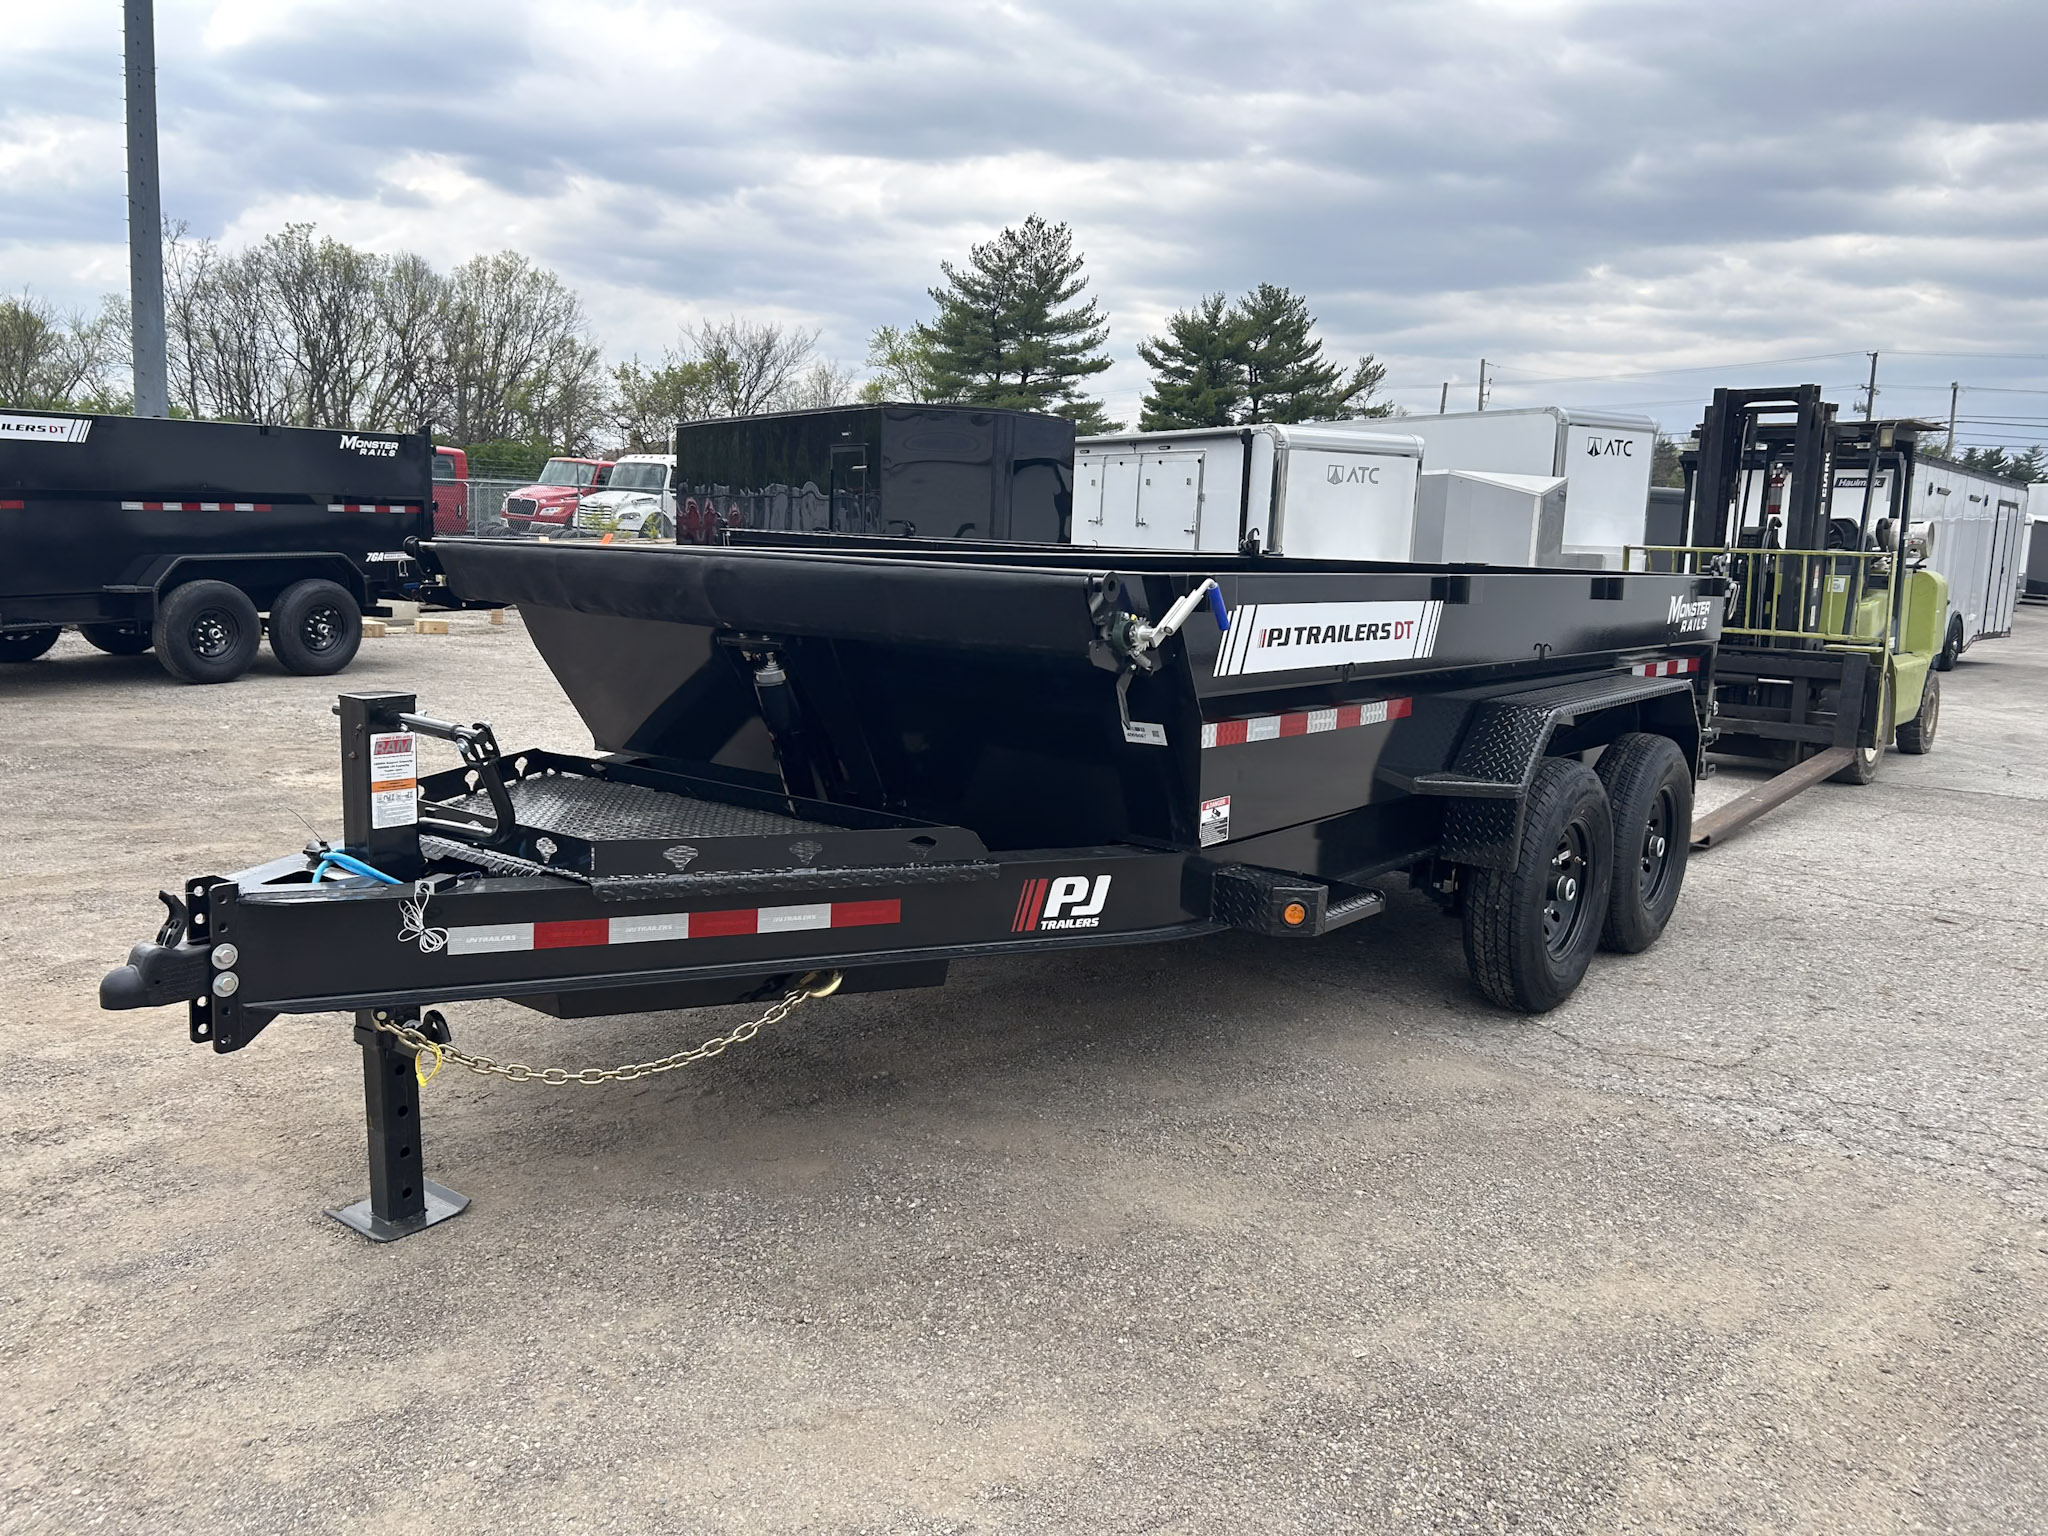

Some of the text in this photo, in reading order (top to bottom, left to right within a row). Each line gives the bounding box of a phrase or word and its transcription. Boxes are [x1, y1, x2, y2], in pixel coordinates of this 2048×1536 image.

[49, 425, 67, 434] DT
[340, 434, 399, 450] MONSTER
[1604, 439, 1633, 457] ATC
[359, 448, 396, 457] RAILS
[1346, 467, 1380, 485] ATC
[1821, 452, 1831, 498] CLARK
[1838, 478, 1881, 487] Haulmk
[365, 552, 385, 562] 7GA
[1667, 594, 1711, 625] MONSTER
[1680, 617, 1708, 633] RAILS
[1294, 622, 1392, 646] TRAILERS
[1394, 621, 1414, 640] DT
[375, 739, 412, 754] RAM
[1043, 875, 1112, 918] PJ
[1041, 917, 1100, 930] TRAILERS
